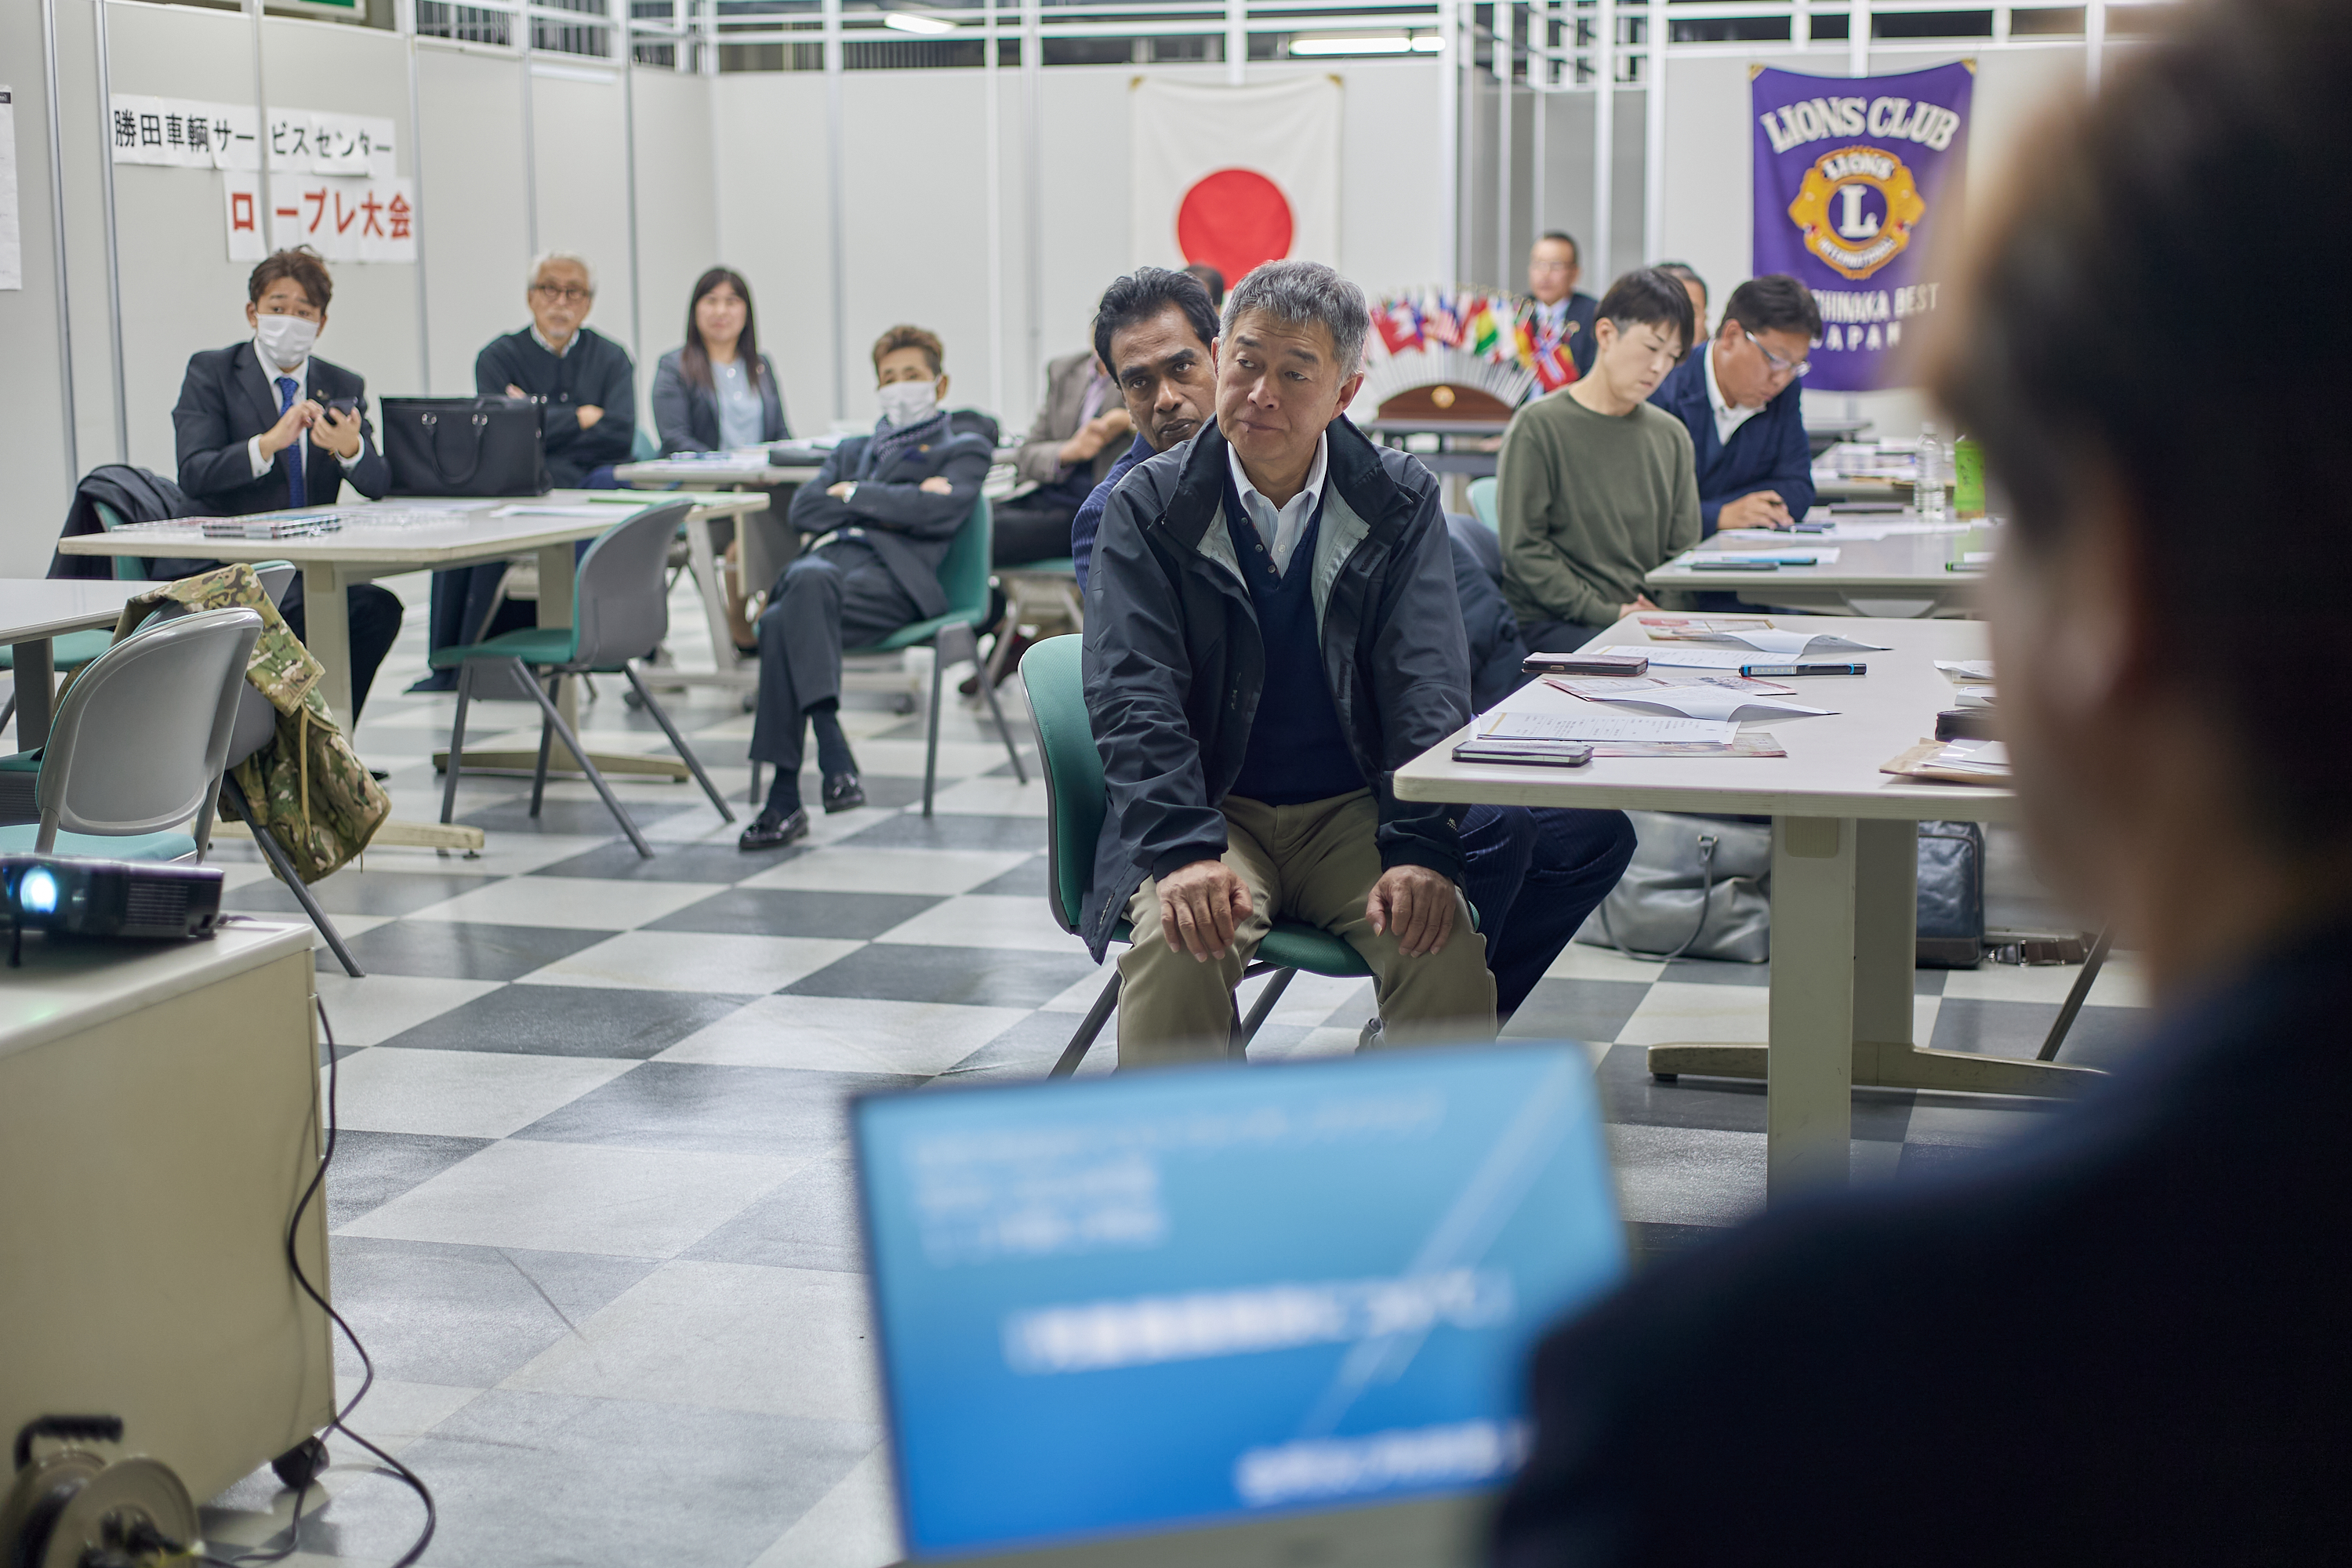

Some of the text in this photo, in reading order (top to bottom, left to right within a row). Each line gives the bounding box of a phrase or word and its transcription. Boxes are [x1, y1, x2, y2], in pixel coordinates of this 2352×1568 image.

[1759, 96, 1959, 154] LIONS CLUB
[1823, 152, 1895, 181] LIONS
[1838, 184, 1879, 238] L
[1894, 283, 1940, 319] BEST
